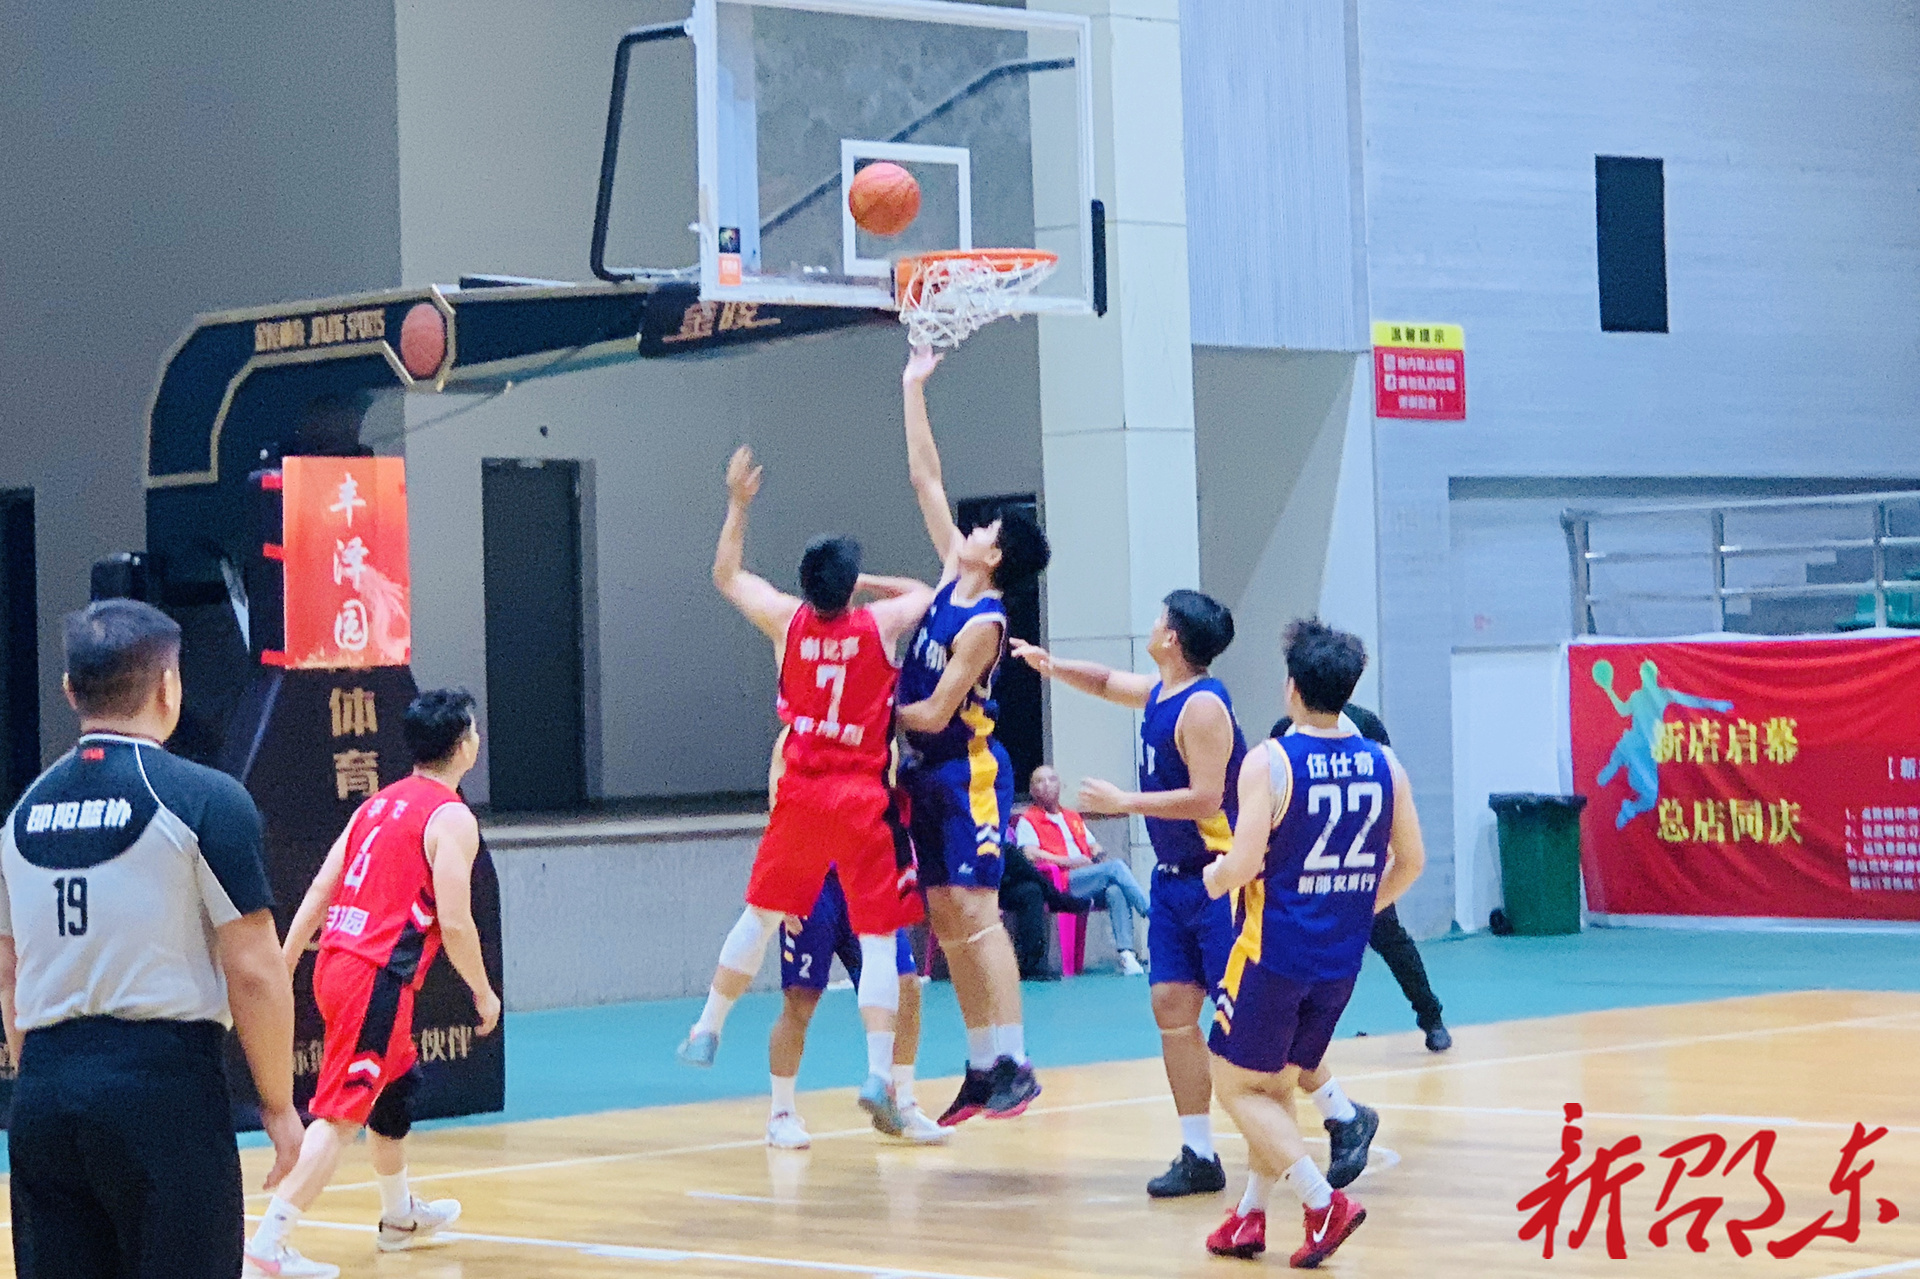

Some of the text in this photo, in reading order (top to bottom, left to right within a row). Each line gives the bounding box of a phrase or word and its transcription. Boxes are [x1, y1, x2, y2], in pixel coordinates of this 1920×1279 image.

[815, 663, 847, 725] 7
[328, 687, 379, 800] 体育
[1651, 717, 1798, 765] 新店启幕
[26, 798, 132, 832] 邵阳篮协
[1303, 782, 1383, 871] 22
[1657, 798, 1803, 845] 总店同庆
[54, 877, 88, 937] 19
[798, 952, 813, 979] 2
